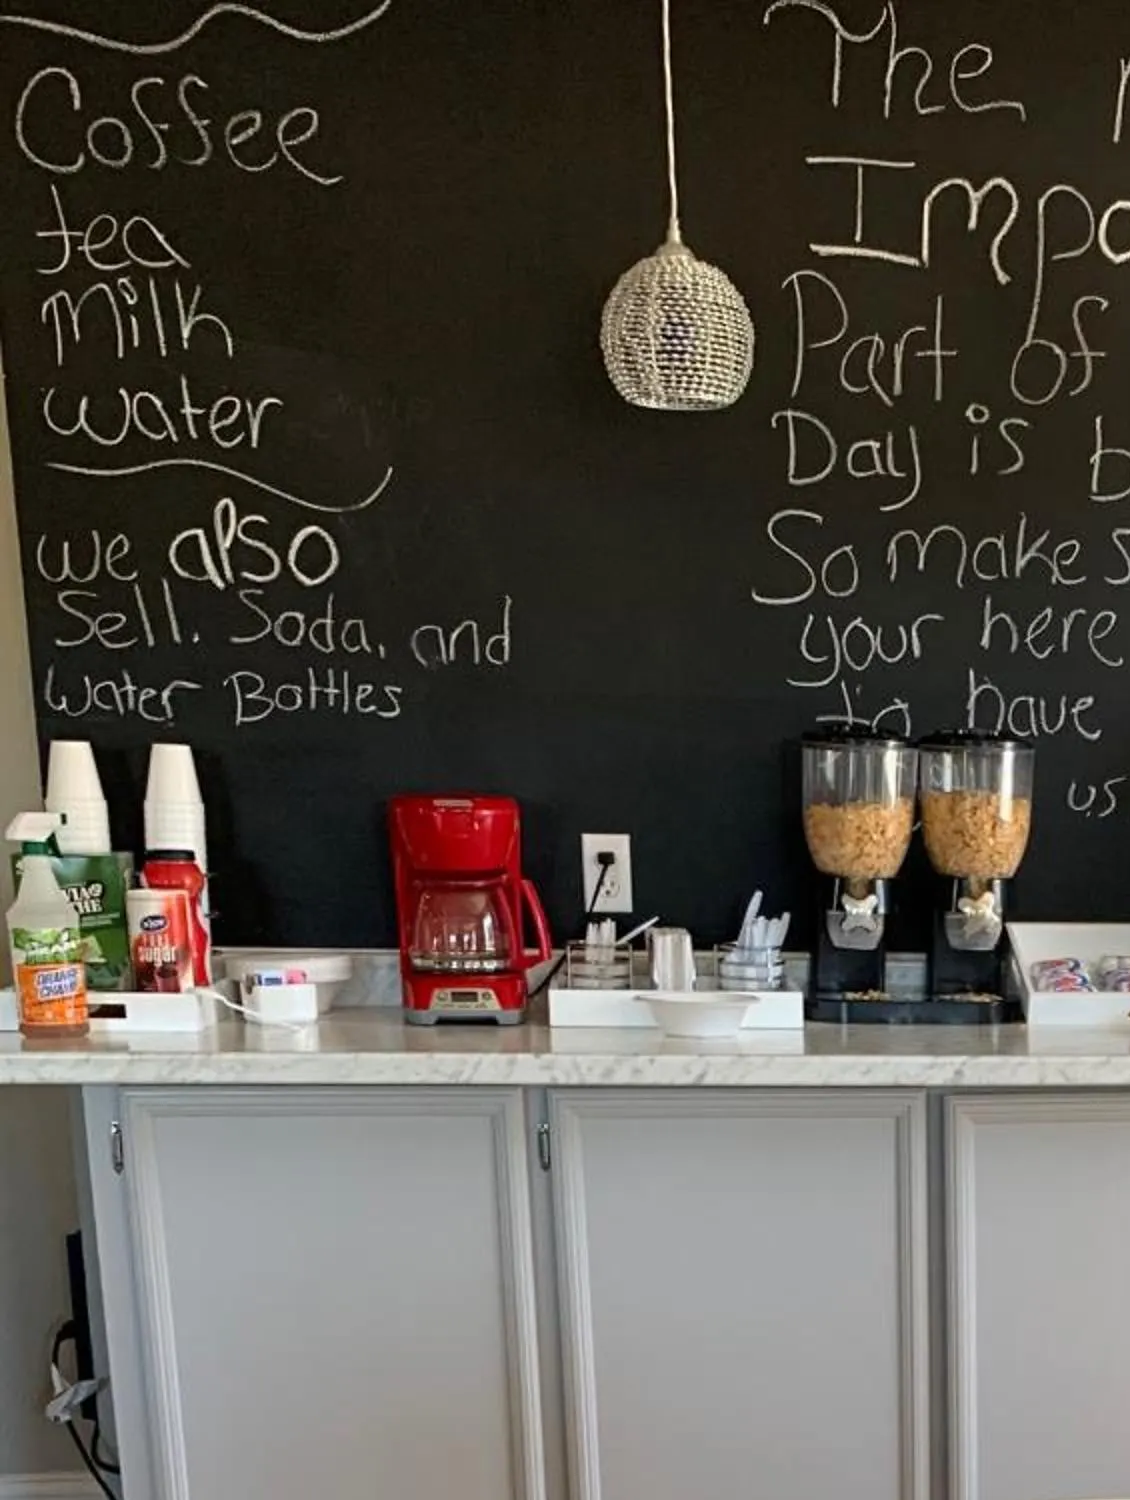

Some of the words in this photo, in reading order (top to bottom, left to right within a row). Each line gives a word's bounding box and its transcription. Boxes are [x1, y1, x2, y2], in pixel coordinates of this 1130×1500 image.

[763, 0, 1026, 122] The
[15, 66, 343, 185] Coffee
[35, 184, 191, 274] tea
[781, 270, 958, 406] Part
[1010, 295, 1108, 405] of
[771, 410, 921, 512] Day
[965, 403, 1031, 475] is
[168, 498, 340, 589] also
[751, 509, 859, 605] So
[410, 595, 512, 666] and
[786, 613, 945, 688] your
[978, 595, 1124, 668] here
[222, 667, 403, 726] Bottles
